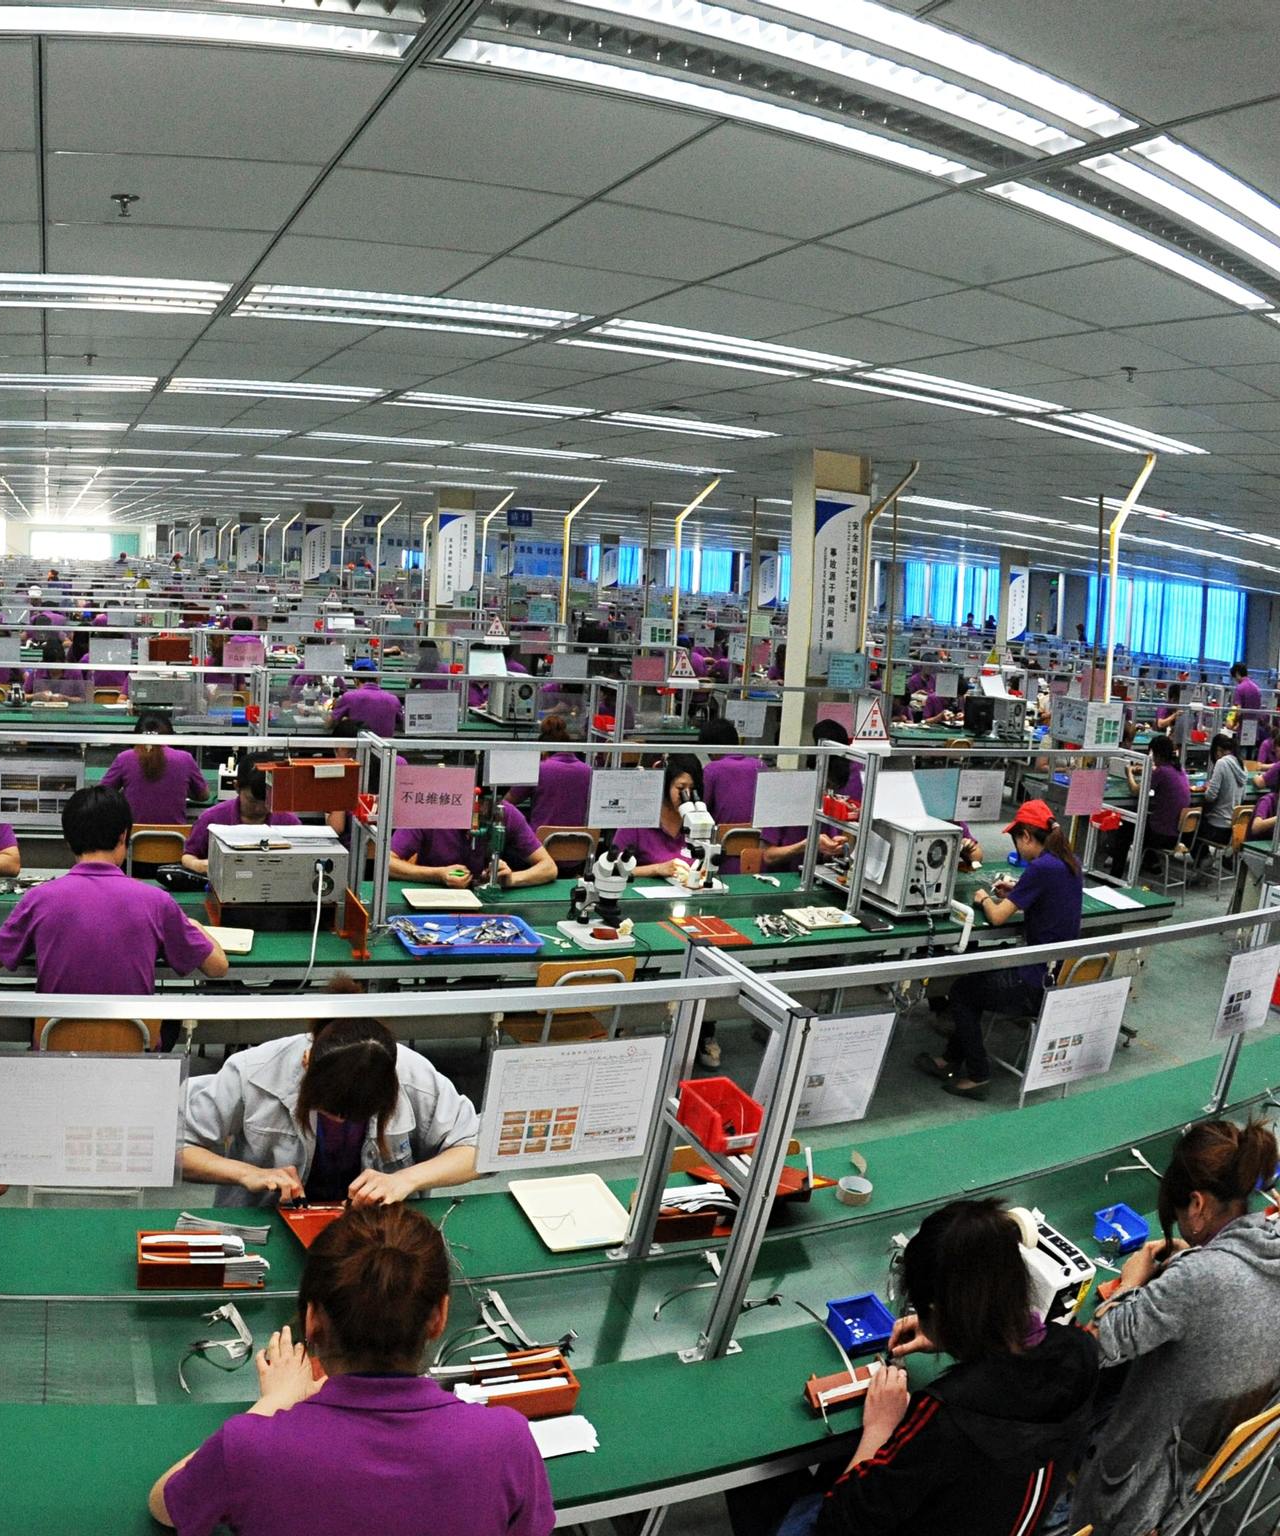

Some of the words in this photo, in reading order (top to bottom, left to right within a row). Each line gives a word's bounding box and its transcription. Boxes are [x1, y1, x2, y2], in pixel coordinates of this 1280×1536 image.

[401, 791, 463, 806] 不良维修区
